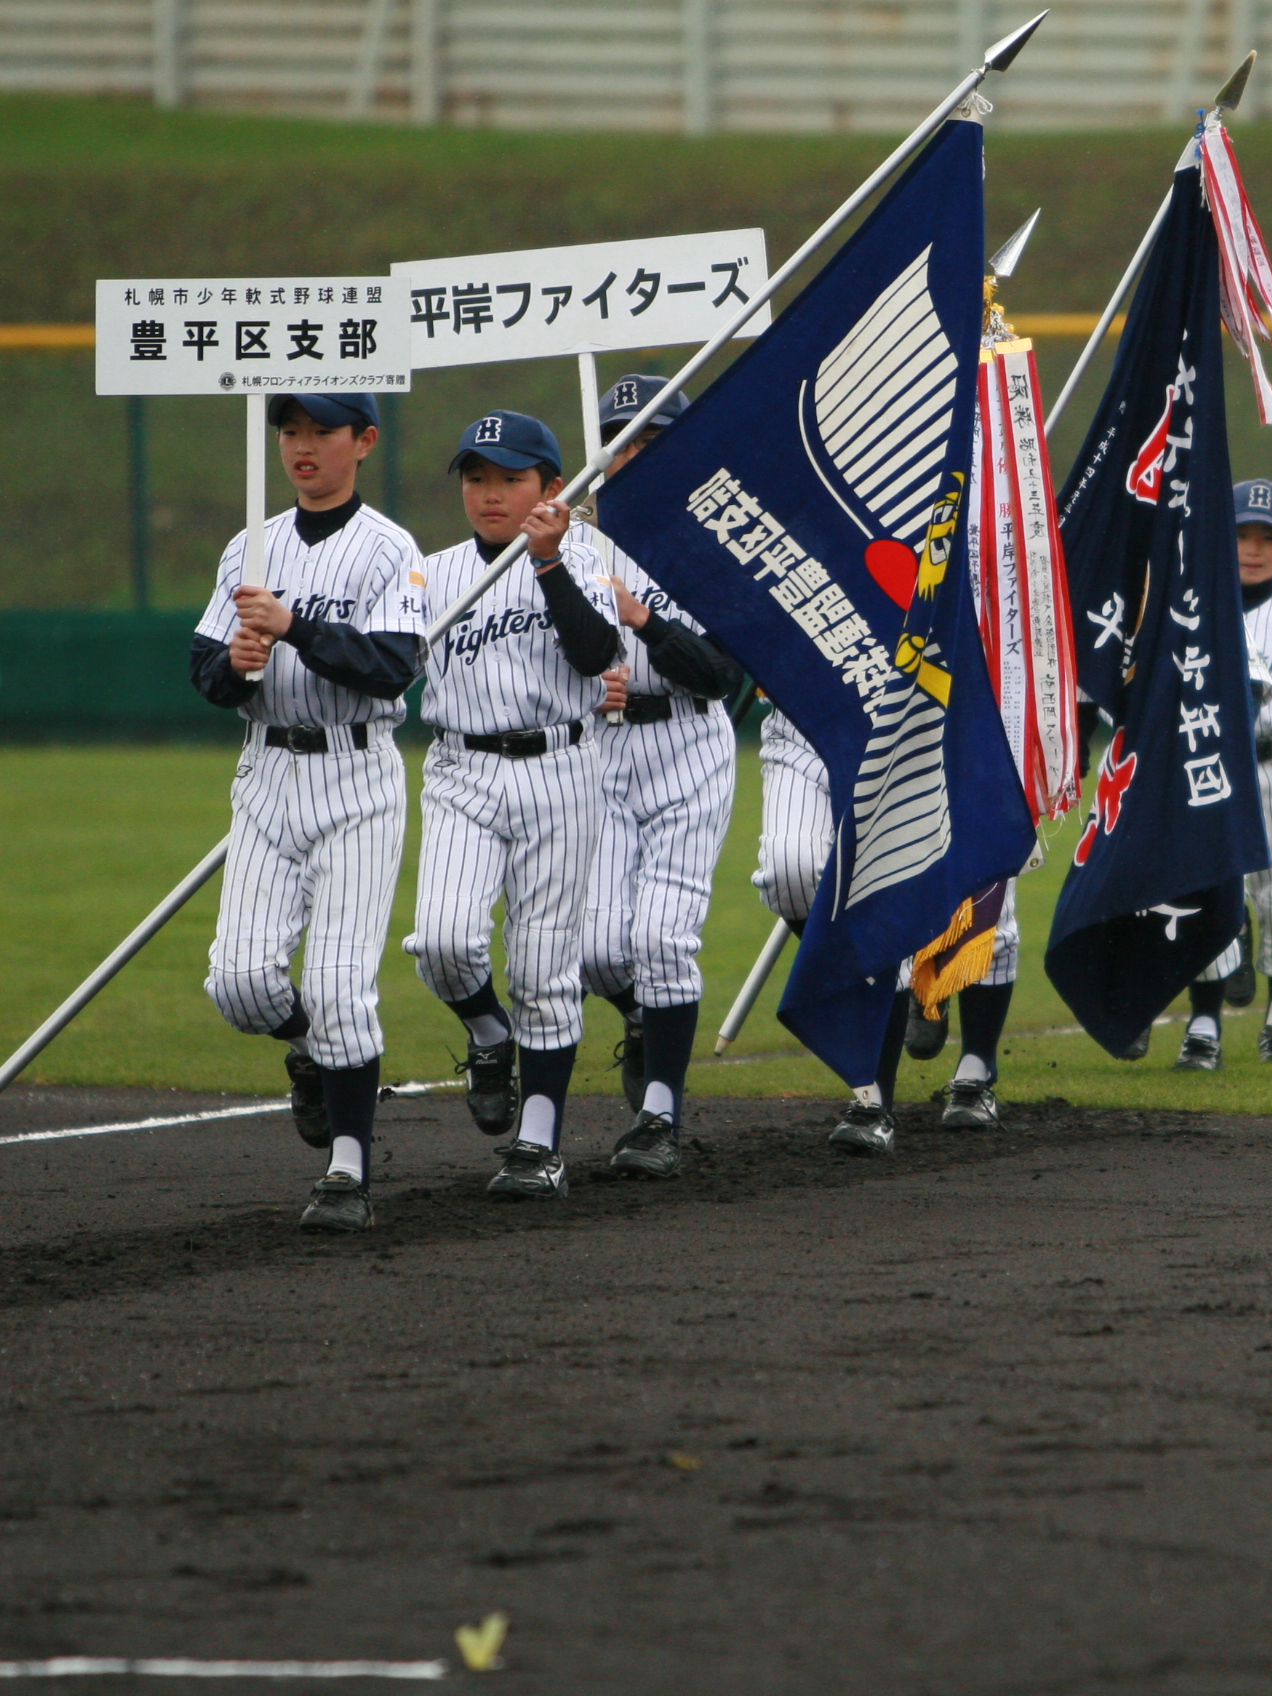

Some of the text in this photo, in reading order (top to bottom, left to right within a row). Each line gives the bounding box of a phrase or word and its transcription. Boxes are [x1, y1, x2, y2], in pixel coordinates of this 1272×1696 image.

[124, 286, 383, 306] 札幌市少年軟式野球連盟
[411, 256, 750, 338] 平岸ファイターズ
[130, 318, 378, 361] 豊平区支部
[241, 374, 405, 387] 札幌フロンティアライオンズクラブ寄贈
[614, 381, 638, 409] H
[475, 416, 502, 443] H
[1249, 485, 1271, 509] H
[1000, 522, 1023, 656] 平岸ファイターズ
